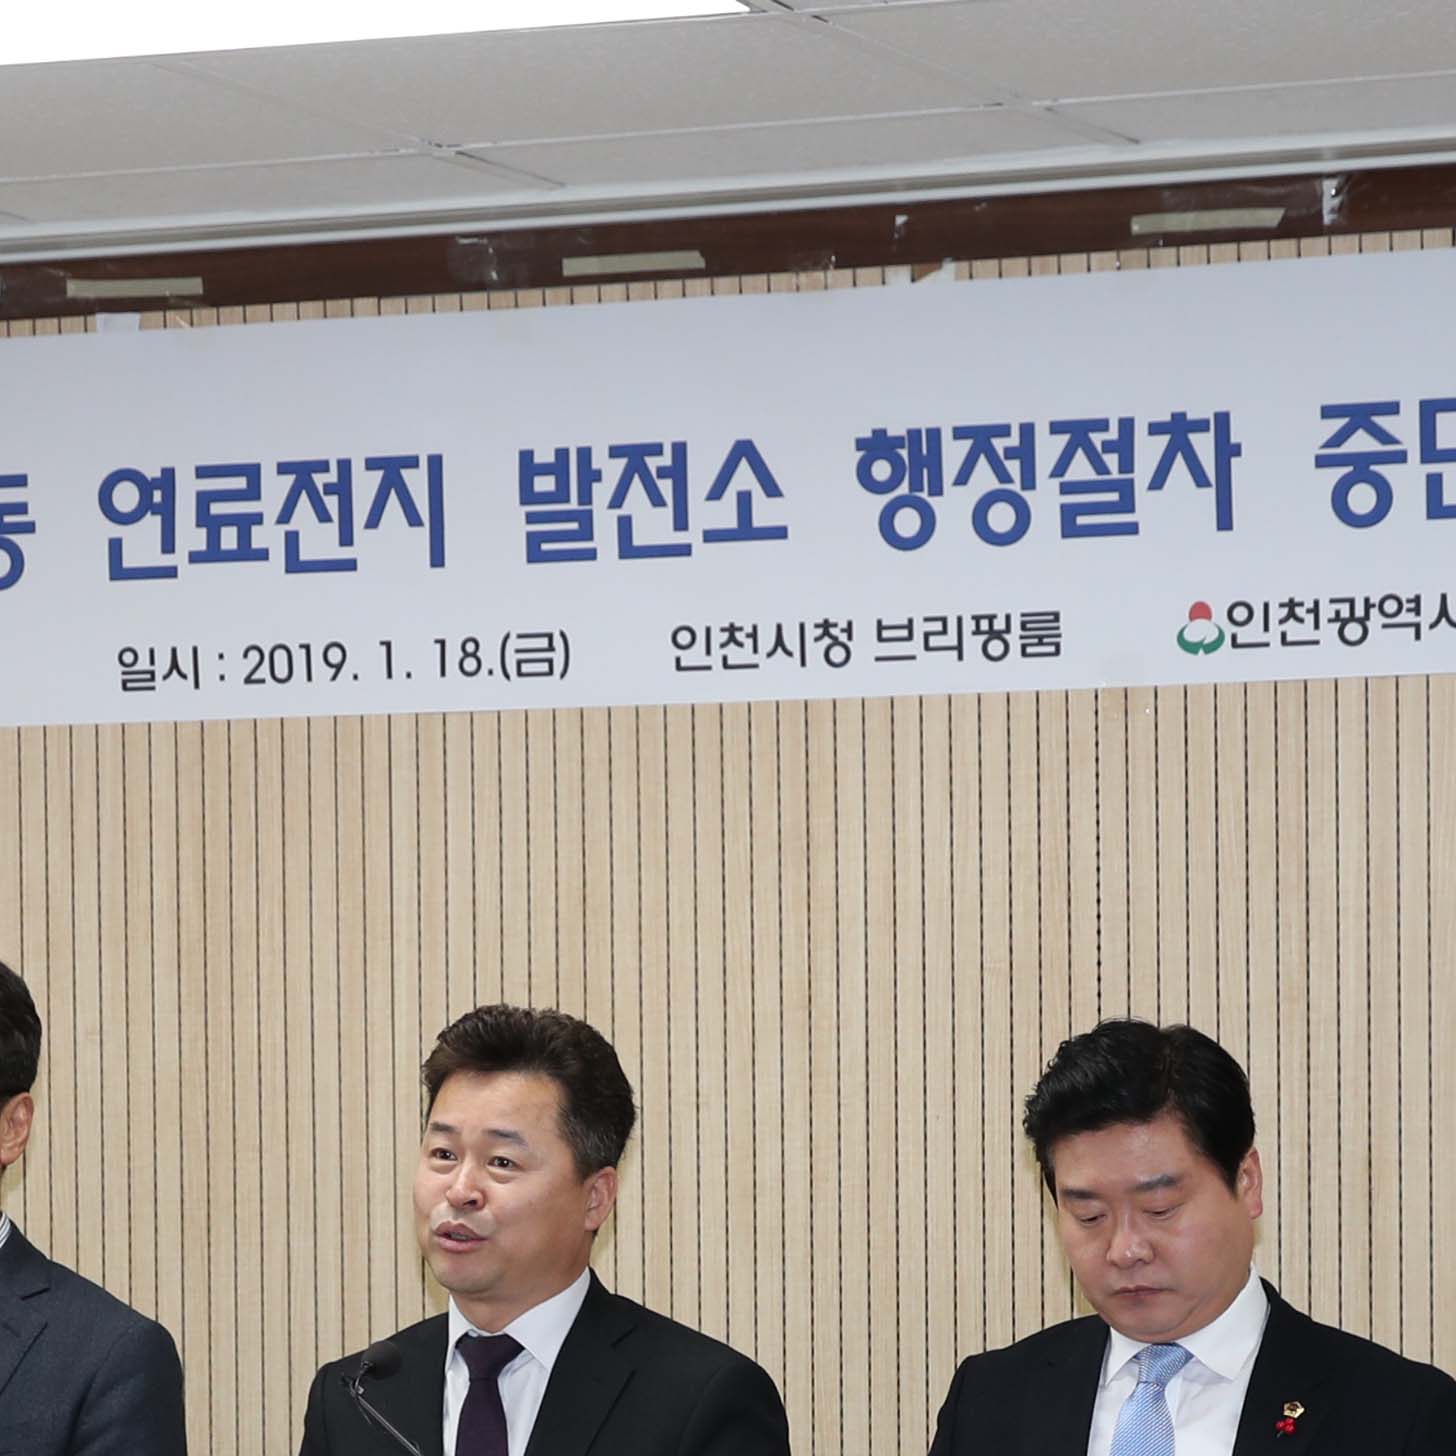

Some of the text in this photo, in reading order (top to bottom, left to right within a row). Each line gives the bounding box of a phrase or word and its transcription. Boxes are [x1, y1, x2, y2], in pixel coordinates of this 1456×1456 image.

[97, 453, 446, 582] 연료전지
[518, 439, 789, 565] 발전소
[854, 410, 1242, 552] 행정절차
[117, 645, 201, 693] 일시
[242, 641, 359, 685] 2019.
[379, 640, 412, 680] 1.
[433, 629, 570, 682] 18.(금)
[670, 610, 1063, 673] 인천시청 브리핑룸
